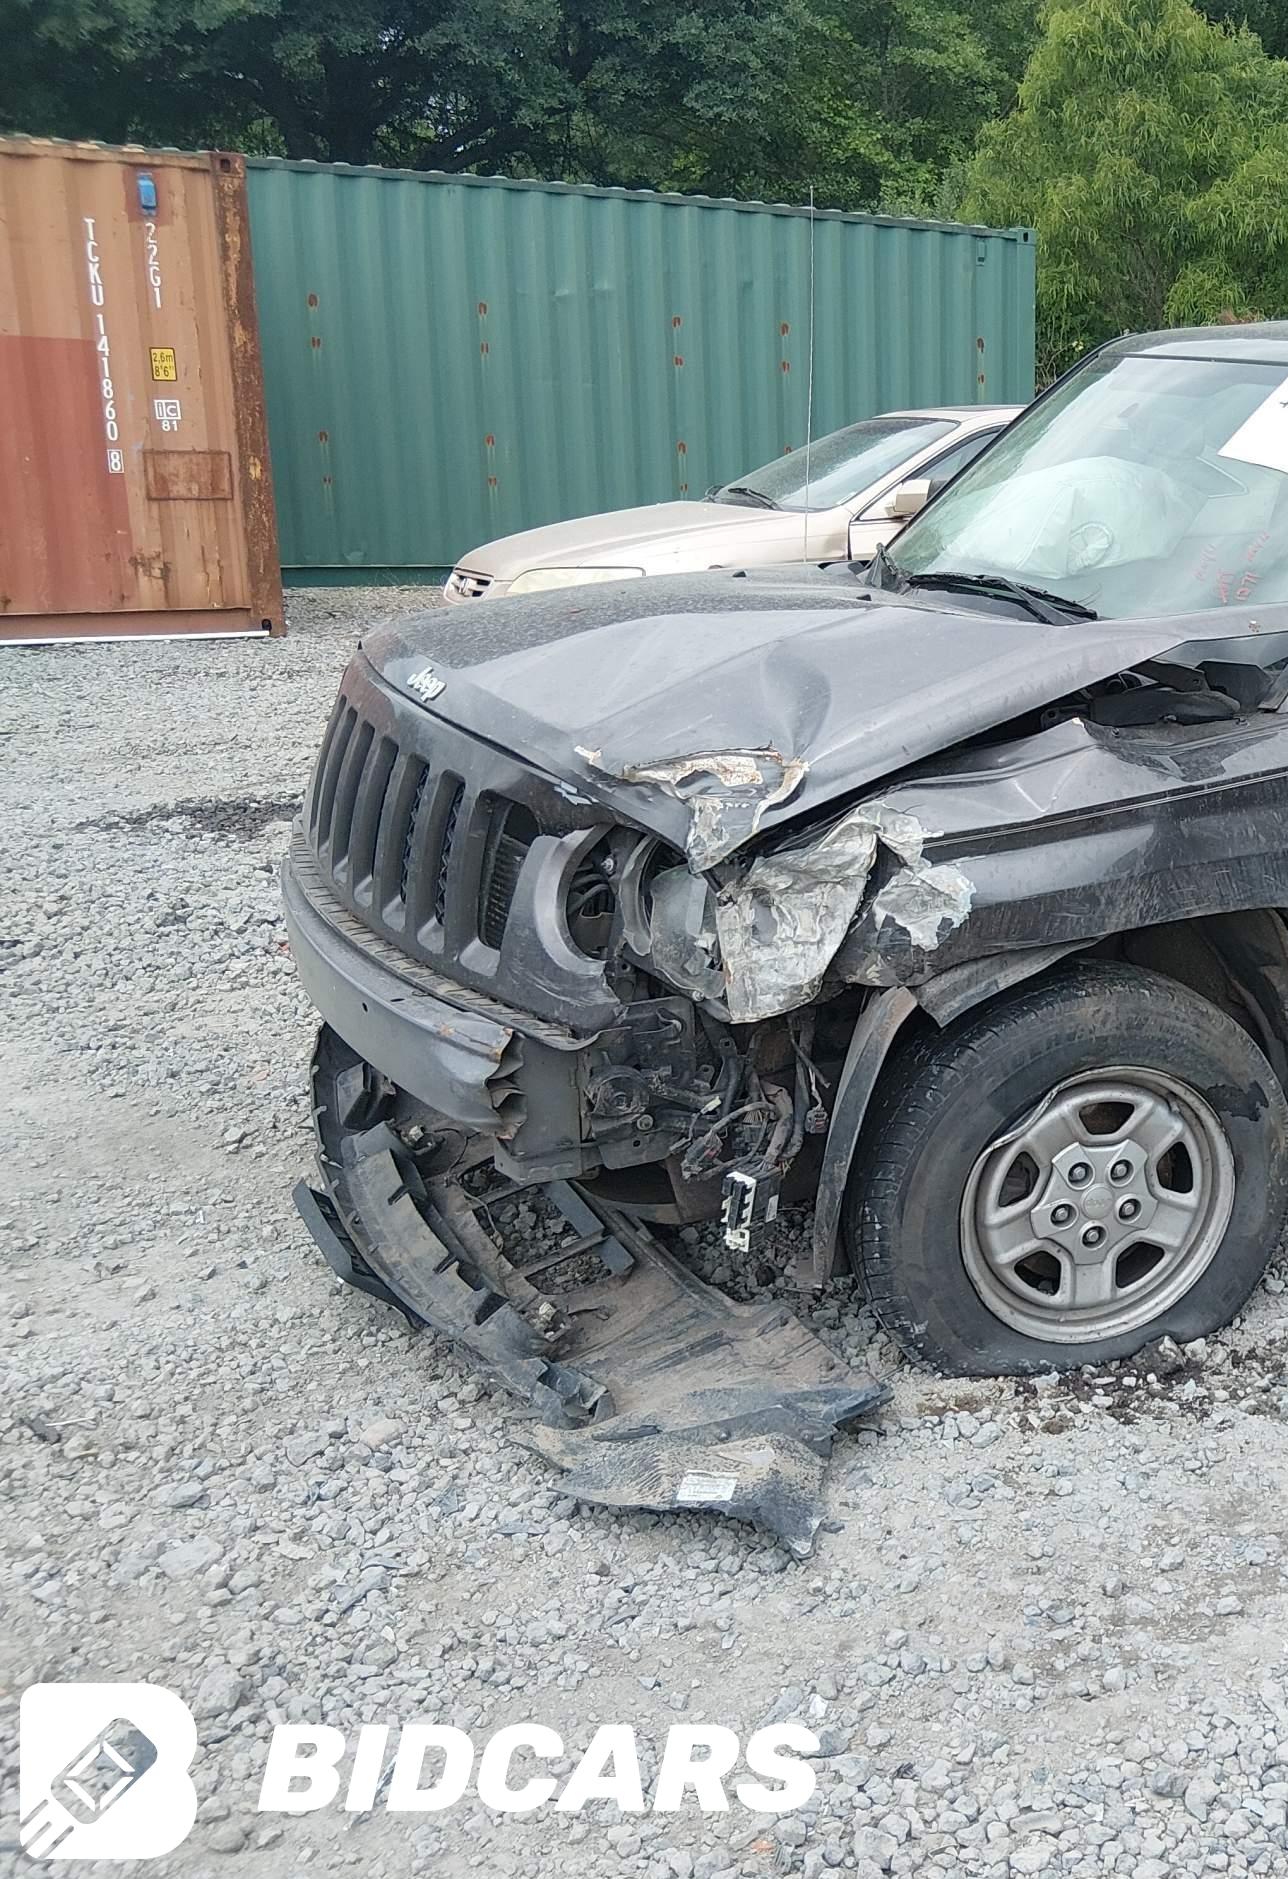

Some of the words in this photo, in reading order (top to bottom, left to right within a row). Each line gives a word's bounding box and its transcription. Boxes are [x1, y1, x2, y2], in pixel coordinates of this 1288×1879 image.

[145, 222, 161, 308] 22G1
[84, 217, 104, 306] TCKU
[97, 313, 119, 441] 141860
[161, 420, 178, 432] 81
